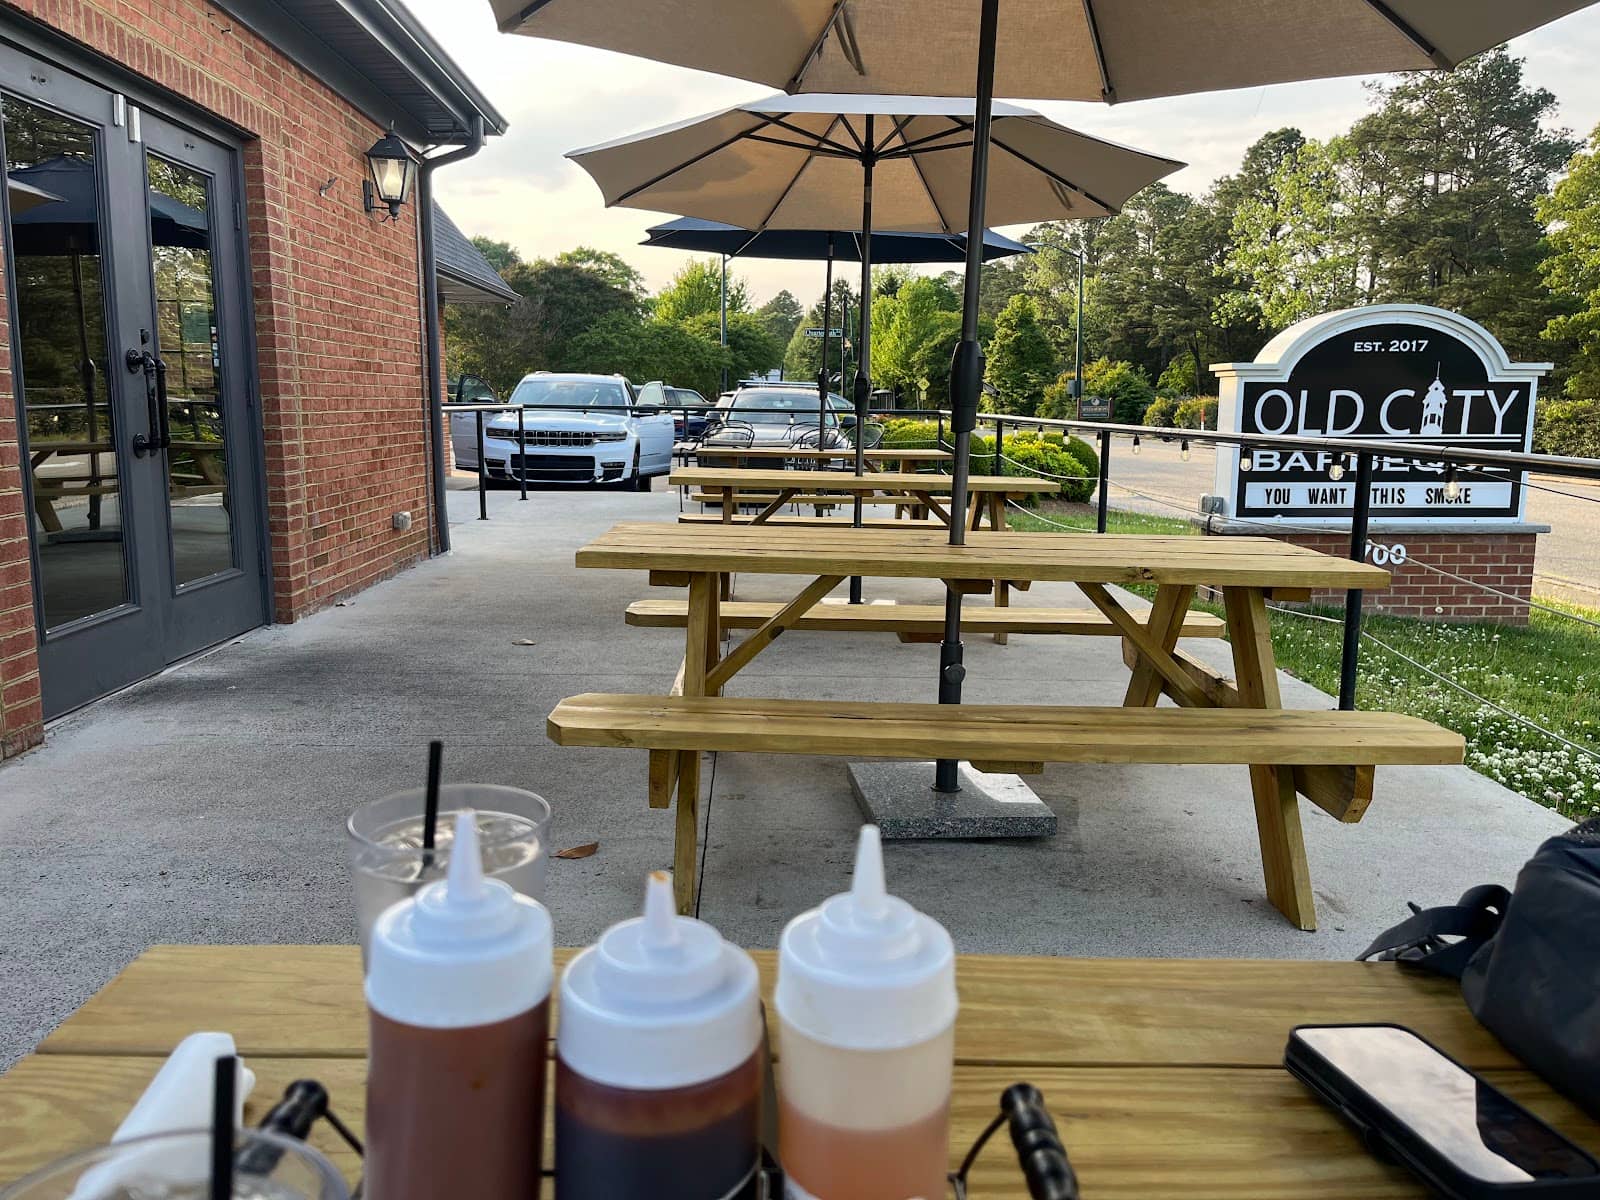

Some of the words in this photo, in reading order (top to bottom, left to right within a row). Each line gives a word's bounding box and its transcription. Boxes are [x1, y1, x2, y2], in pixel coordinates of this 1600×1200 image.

[1353, 341, 1385, 352] EST.
[1389, 339, 1429, 352] 2017
[1254, 388, 1365, 436] OLD
[1252, 449, 1510, 475] BAREQ
[1265, 487, 1291, 504] YOU
[1308, 487, 1348, 504] WANT
[1371, 487, 1405, 504] THIS
[1425, 487, 1472, 504] SMKE
